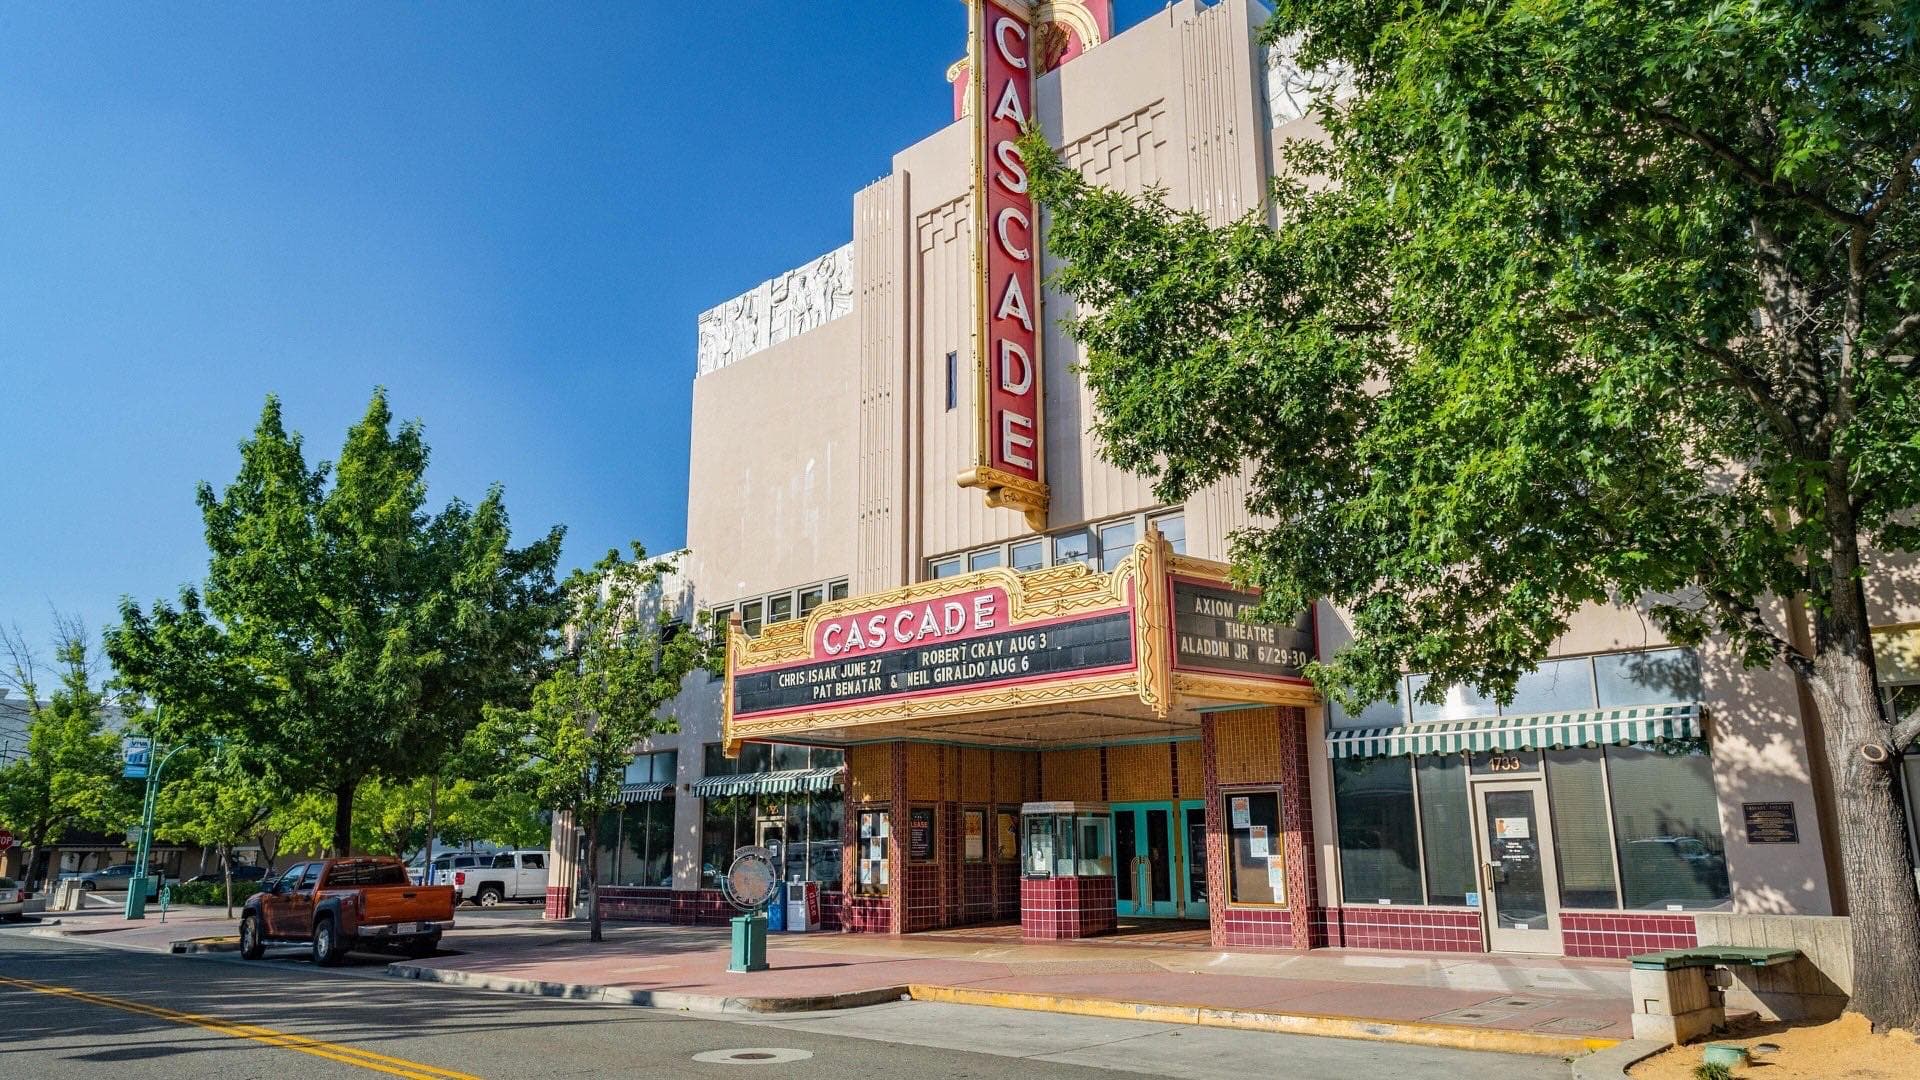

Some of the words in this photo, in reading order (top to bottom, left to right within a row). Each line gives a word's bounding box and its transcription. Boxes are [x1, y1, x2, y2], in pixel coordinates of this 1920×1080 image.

[994, 17, 1034, 471] CASCADE
[1195, 597, 1234, 618] AXIOM
[822, 594, 996, 655] CASCADE
[1225, 622, 1275, 644] THEATRE
[922, 645, 967, 667] ROBERT
[971, 640, 1003, 658] CRAY
[1009, 634, 1036, 654] AUG
[1039, 632, 1047, 649] 3
[1181, 636, 1230, 658] ALADDIN
[1234, 643, 1249, 660] JR
[1257, 646, 1307, 668] 6/29-30
[779, 671, 805, 687] CHRIS
[808, 666, 837, 683] ISAAK
[841, 661, 867, 678] JUNE
[870, 659, 882, 674] 27
[813, 683, 832, 699] PAT
[835, 677, 882, 696] BENATAR
[890, 674, 898, 689] &
[907, 670, 930, 687] NEIL
[934, 662, 985, 683] GIRALDO
[990, 657, 1016, 676] AUG
[1021, 655, 1030, 672] 6
[1489, 757, 1520, 771] 1733
